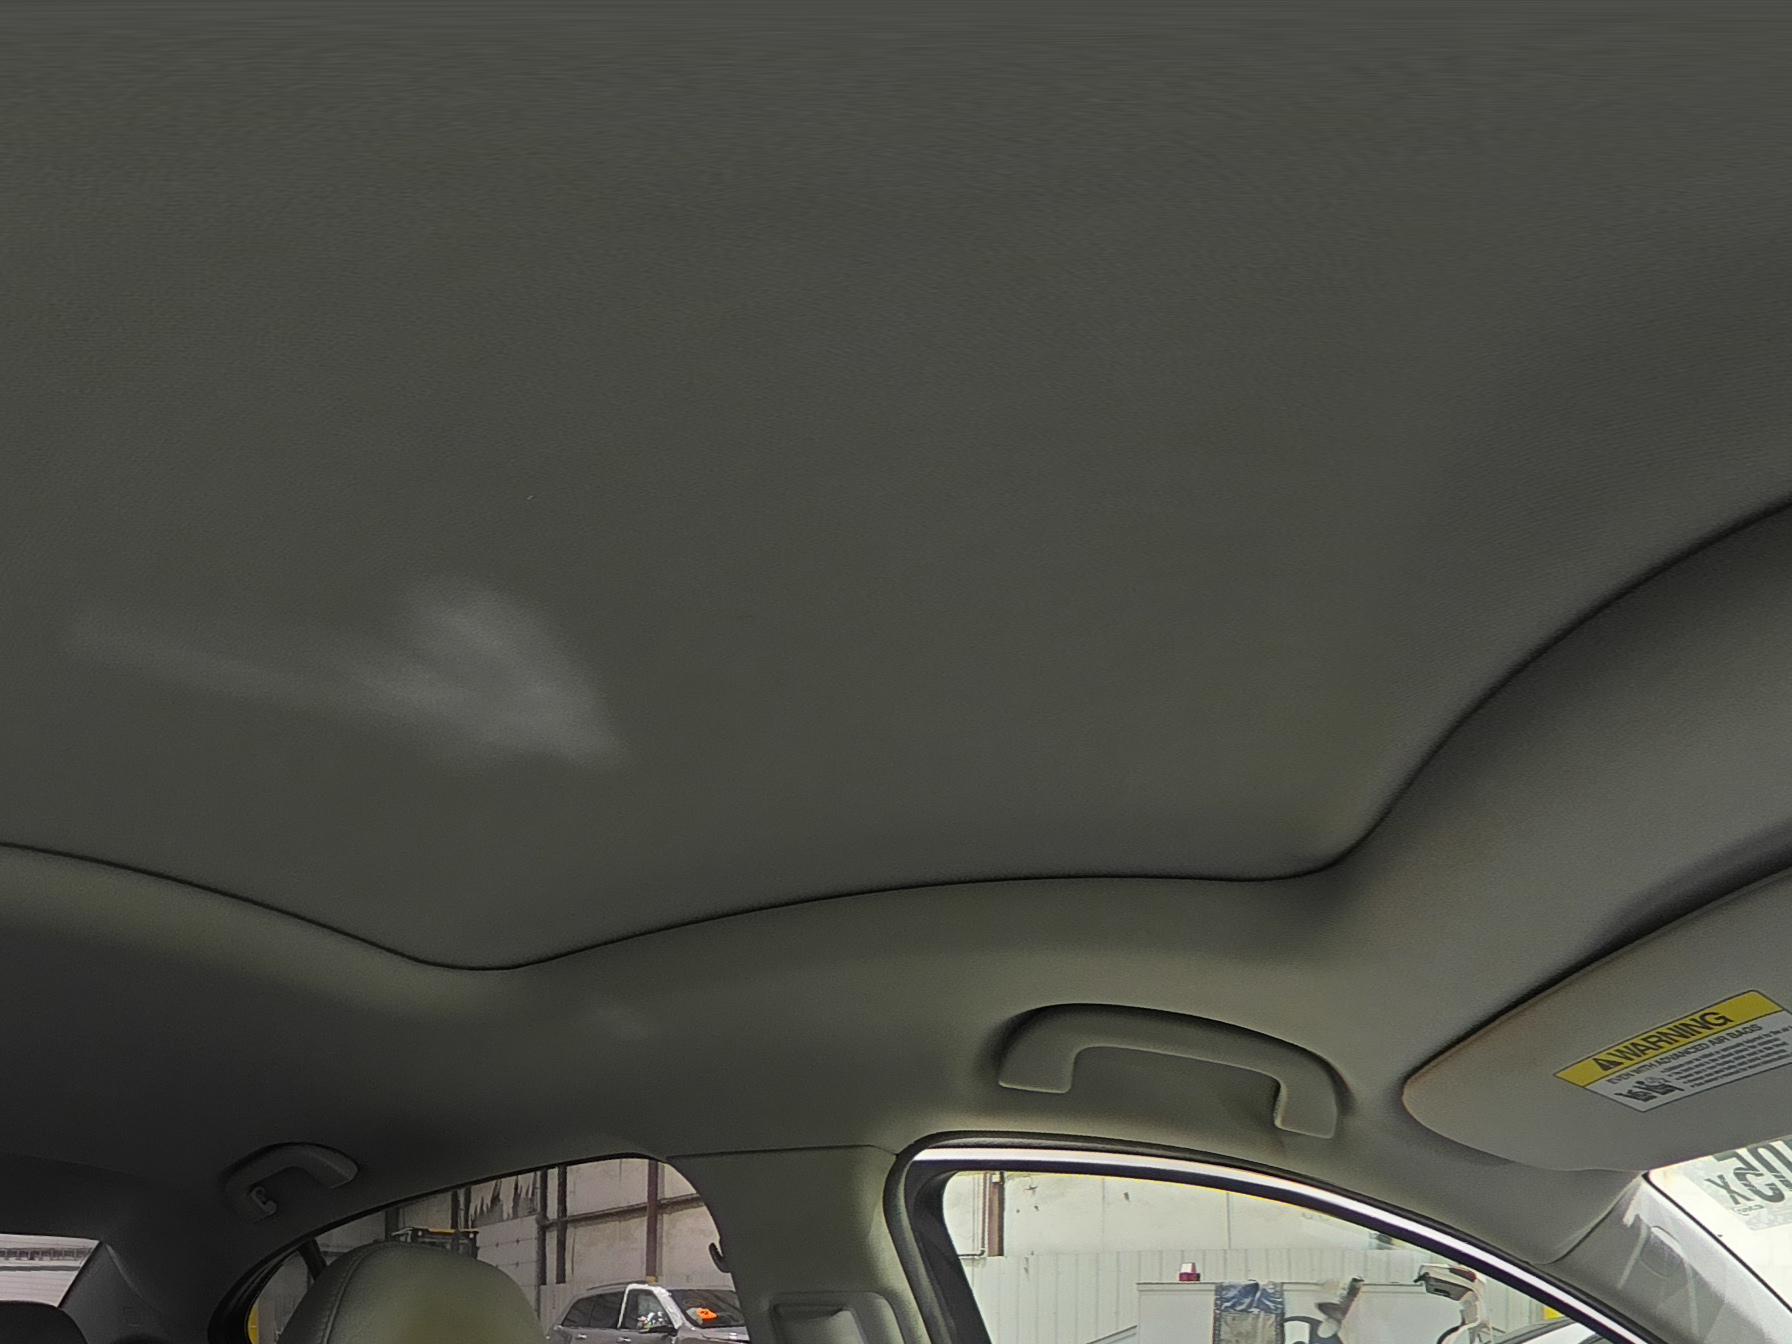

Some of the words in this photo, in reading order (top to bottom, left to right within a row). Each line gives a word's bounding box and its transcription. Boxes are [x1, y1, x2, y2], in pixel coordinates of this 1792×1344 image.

[1607, 1073, 1634, 1085] EVEN
[1632, 1063, 1657, 1077] WITH
[1654, 1041, 1710, 1067] ADVANCED
[1709, 1034, 1728, 1048] AIR
[1726, 1024, 1764, 1040] BAGS
[1611, 1011, 1734, 1061] WARNING
